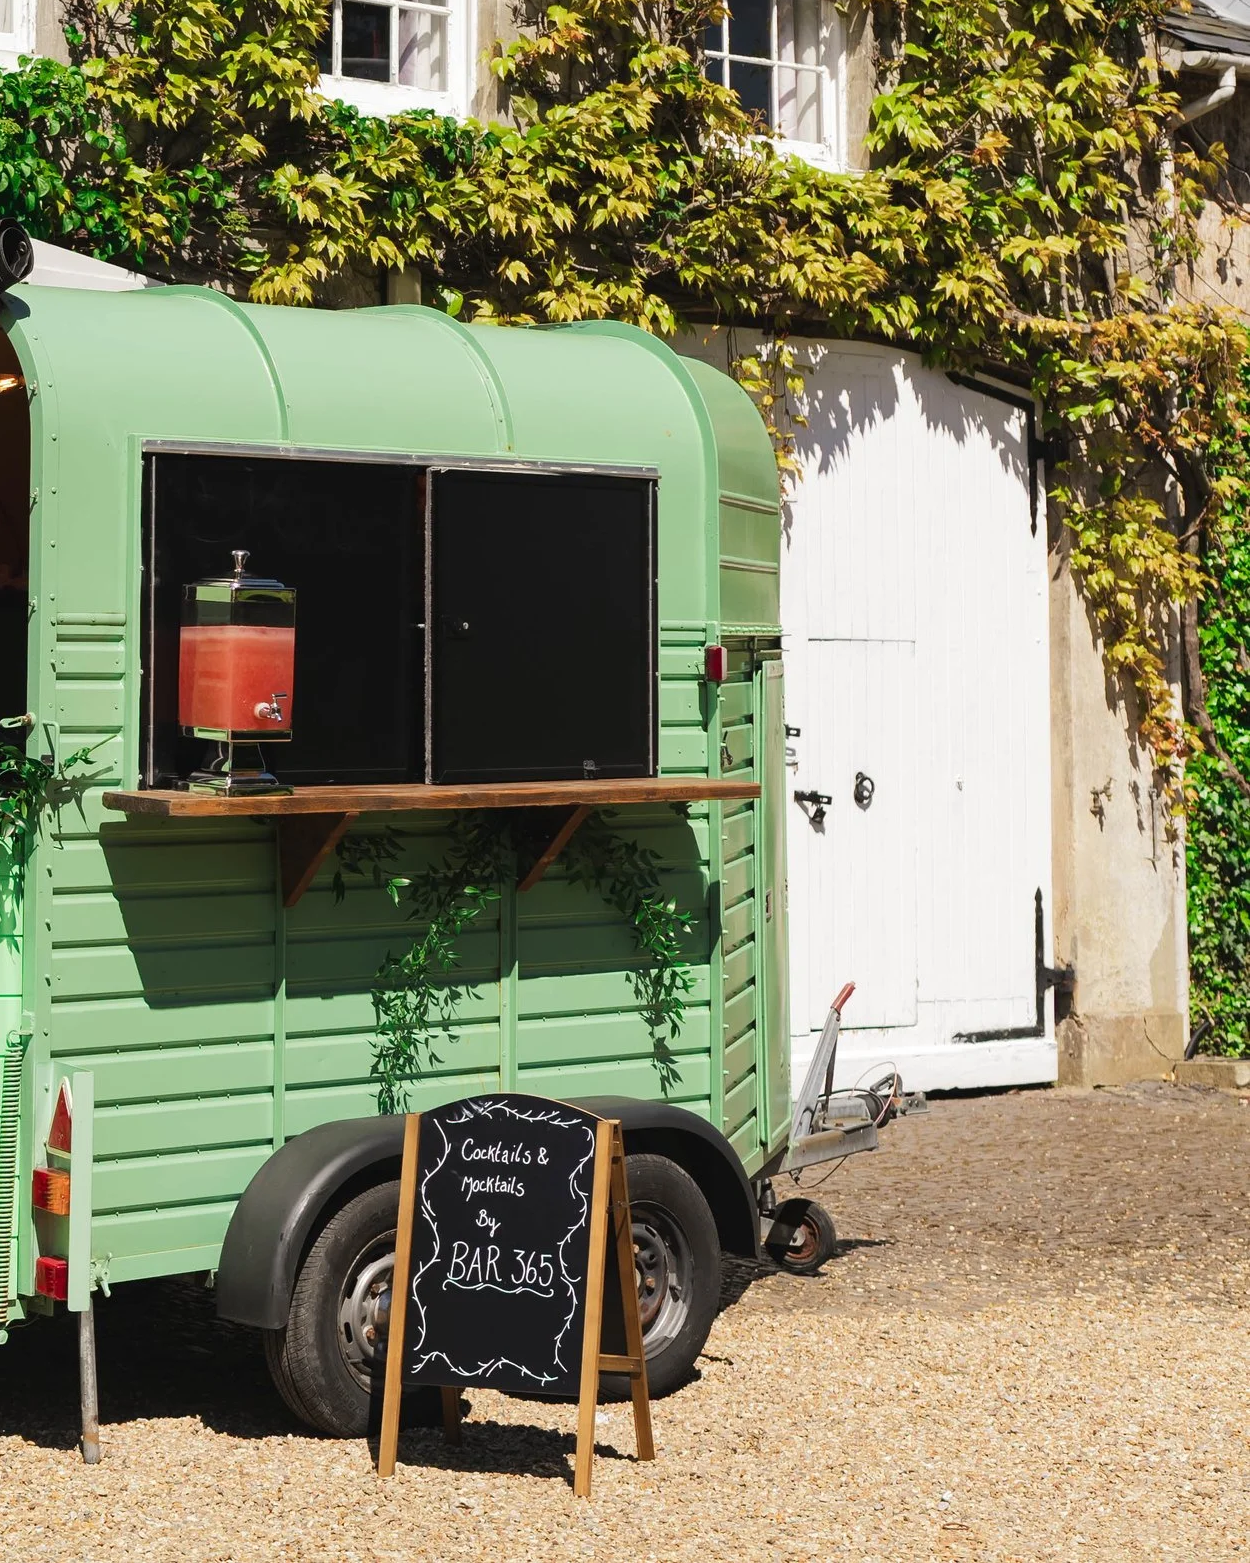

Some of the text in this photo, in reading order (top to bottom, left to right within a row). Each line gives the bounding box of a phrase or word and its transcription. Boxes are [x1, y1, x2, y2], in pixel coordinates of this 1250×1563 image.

[461, 1137, 550, 1166] Cocktails &
[461, 1175, 525, 1202] Mocktails
[475, 1208, 501, 1238] By
[447, 1240, 554, 1287] BAR 365
